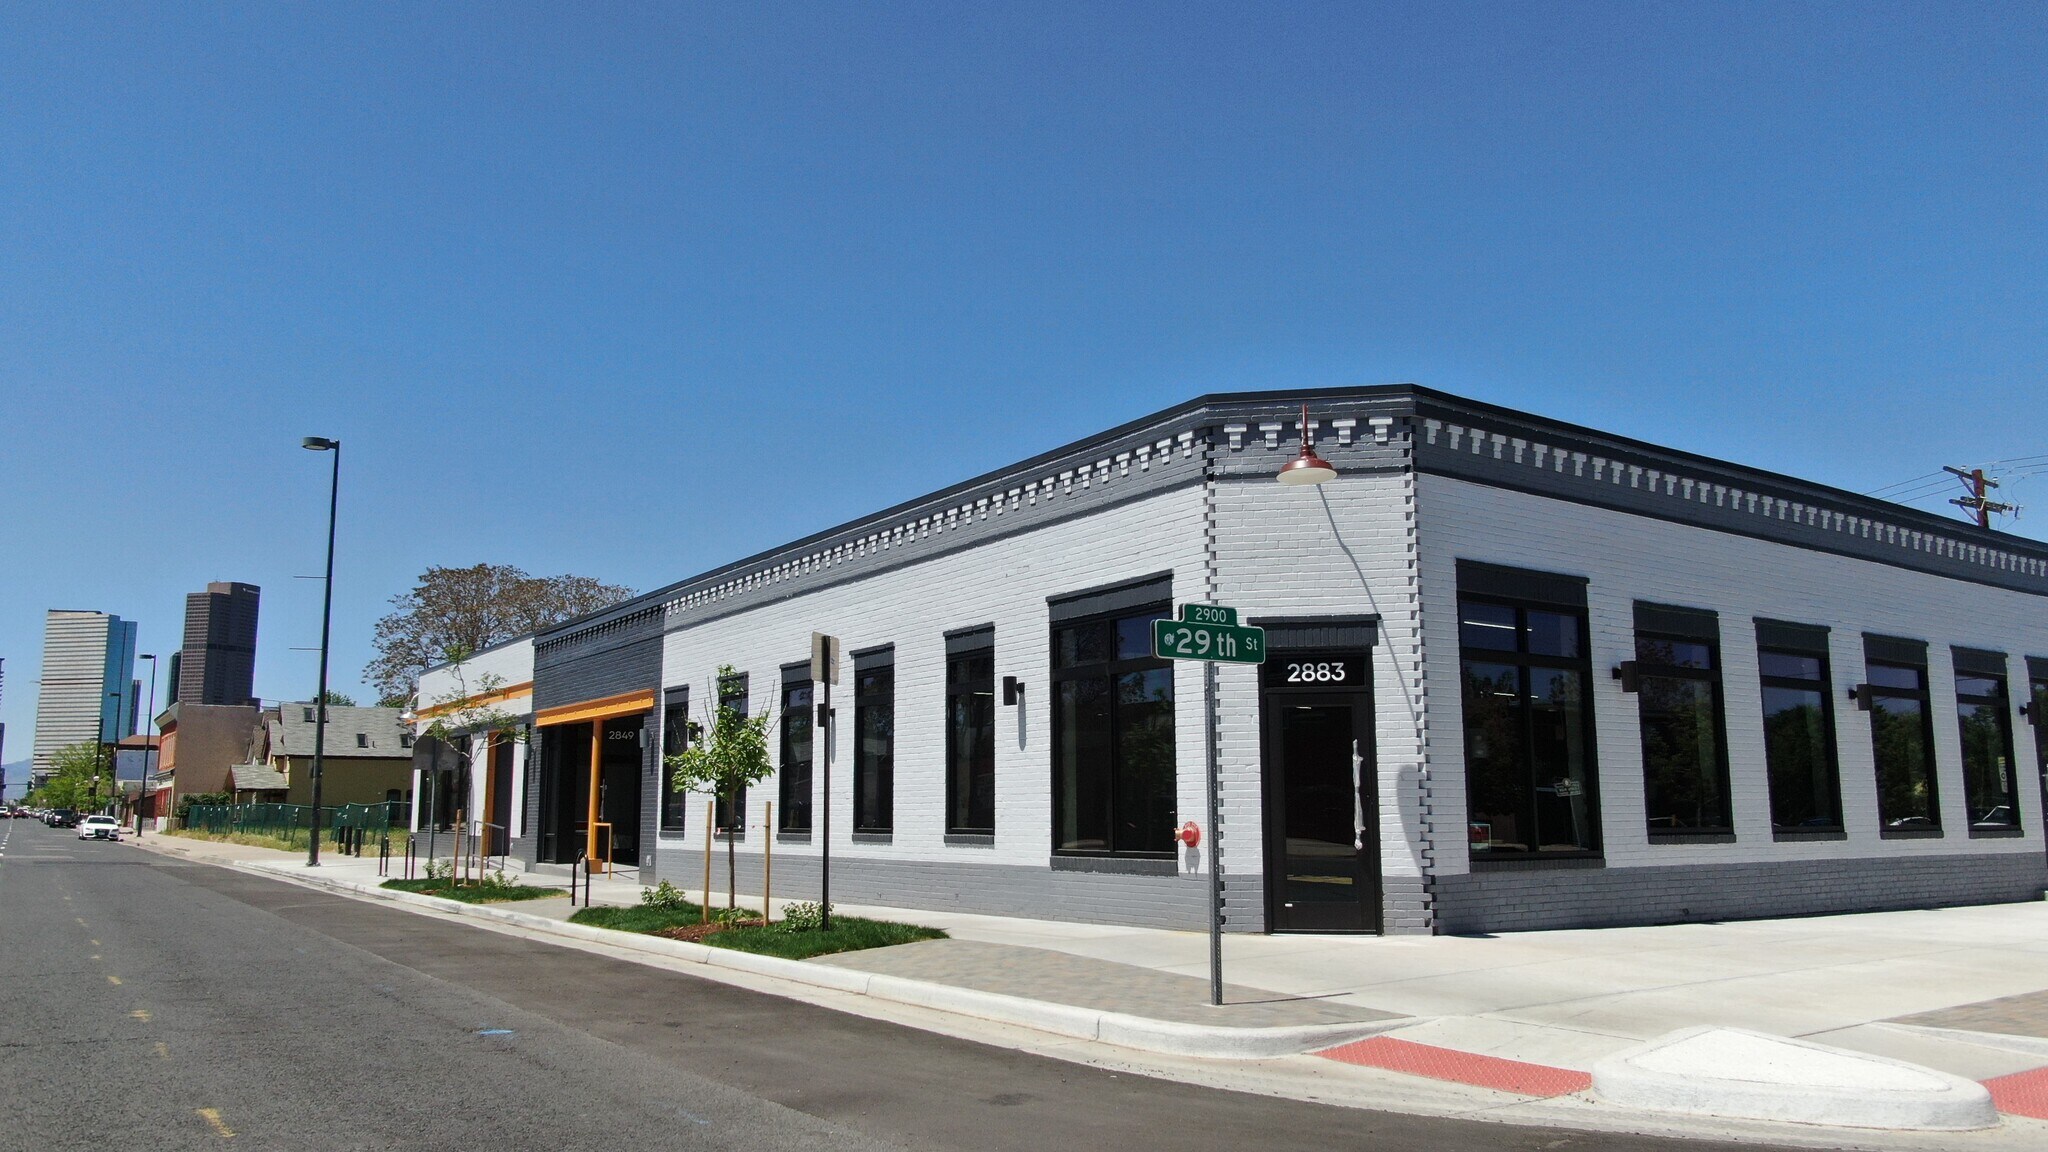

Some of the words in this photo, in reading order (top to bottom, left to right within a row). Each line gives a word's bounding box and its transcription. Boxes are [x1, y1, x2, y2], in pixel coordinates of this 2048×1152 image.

[1195, 607, 1227, 623] 2900
[1245, 636, 1258, 651] St
[1287, 662, 1346, 682] 2883
[608, 730, 635, 740] 2849
